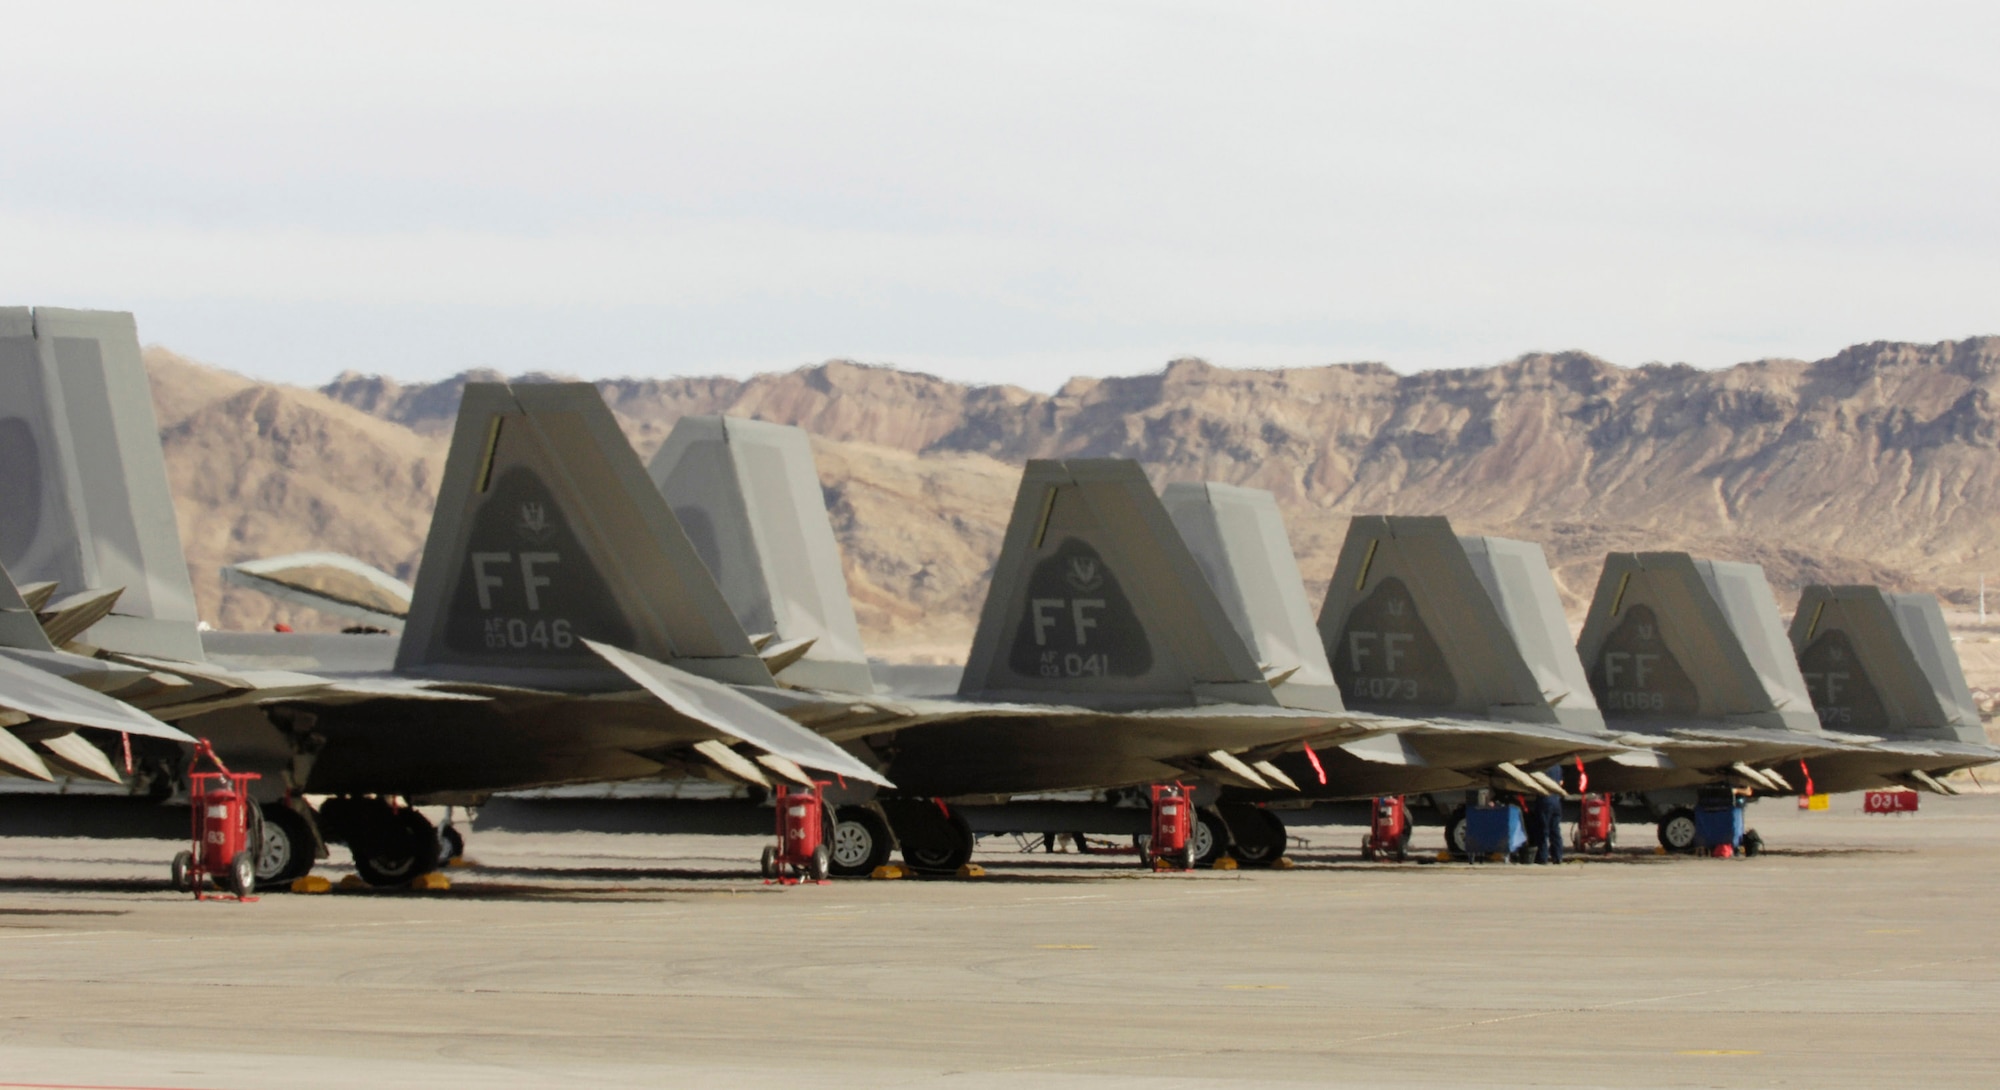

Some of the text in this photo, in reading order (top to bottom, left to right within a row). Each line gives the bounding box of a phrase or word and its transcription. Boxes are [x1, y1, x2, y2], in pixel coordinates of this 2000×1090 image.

[471, 552, 561, 610] FF
[507, 618, 574, 648] 046
[1032, 598, 1106, 645] FF
[1064, 653, 1109, 677] 041
[1349, 631, 1414, 672] FF
[1605, 652, 1660, 688] FF
[1369, 678, 1419, 700] 073
